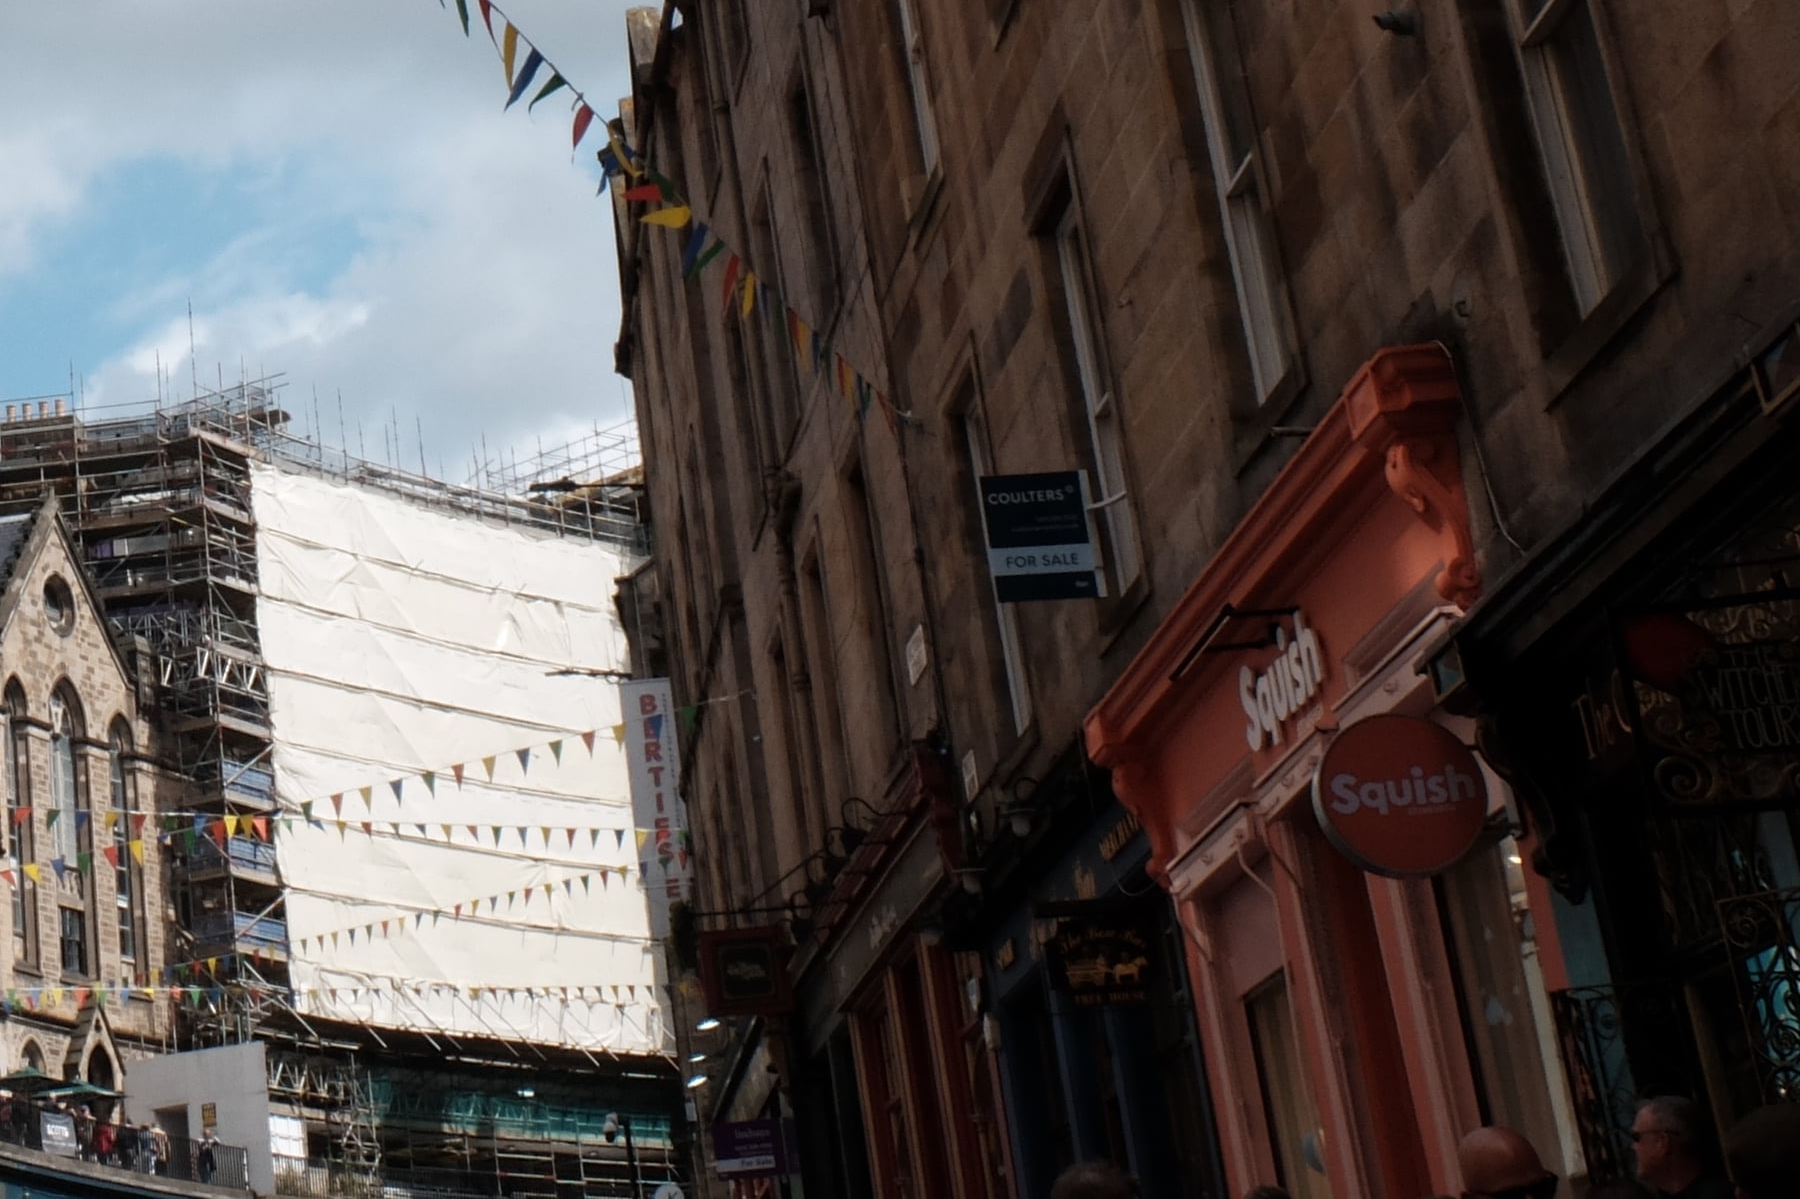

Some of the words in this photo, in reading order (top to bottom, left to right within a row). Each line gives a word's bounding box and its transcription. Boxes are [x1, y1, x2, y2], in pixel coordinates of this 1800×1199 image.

[987, 488, 1065, 506] COULTERS
[1006, 555, 1038, 568] FOR
[1041, 552, 1081, 566] SALE
[1240, 609, 1325, 753] Squish
[1717, 704, 1800, 749] TOUR
[1330, 763, 1477, 816] Squish
